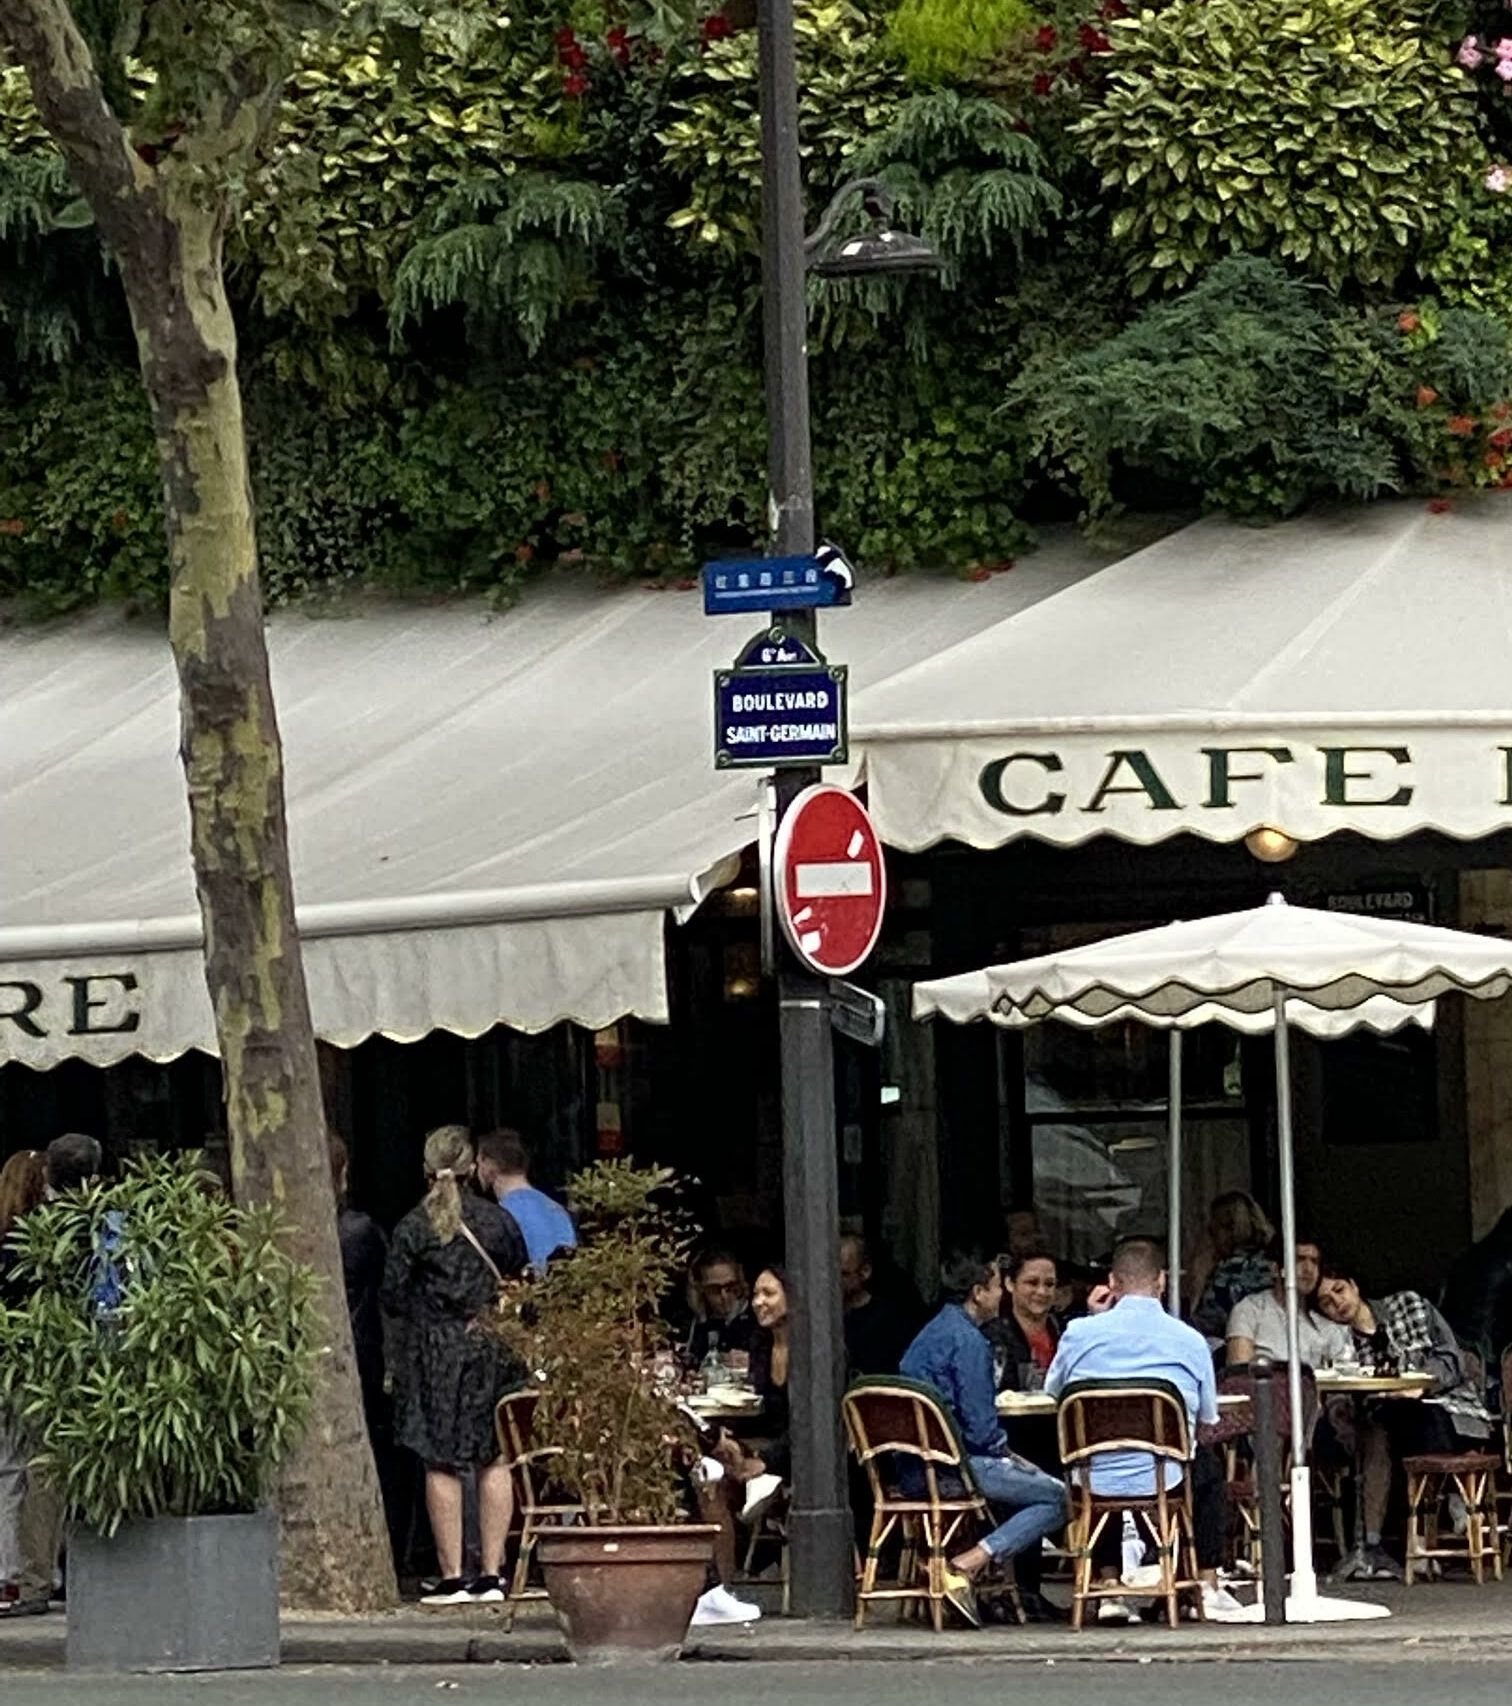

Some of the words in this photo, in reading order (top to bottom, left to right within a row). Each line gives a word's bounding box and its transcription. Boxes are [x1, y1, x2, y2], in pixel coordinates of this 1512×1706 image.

[732, 691, 829, 712] BOULEVARD
[726, 723, 836, 744] SAINT-GERMAIN
[978, 746, 1414, 816] CAFE
[0, 972, 140, 1038] RE
